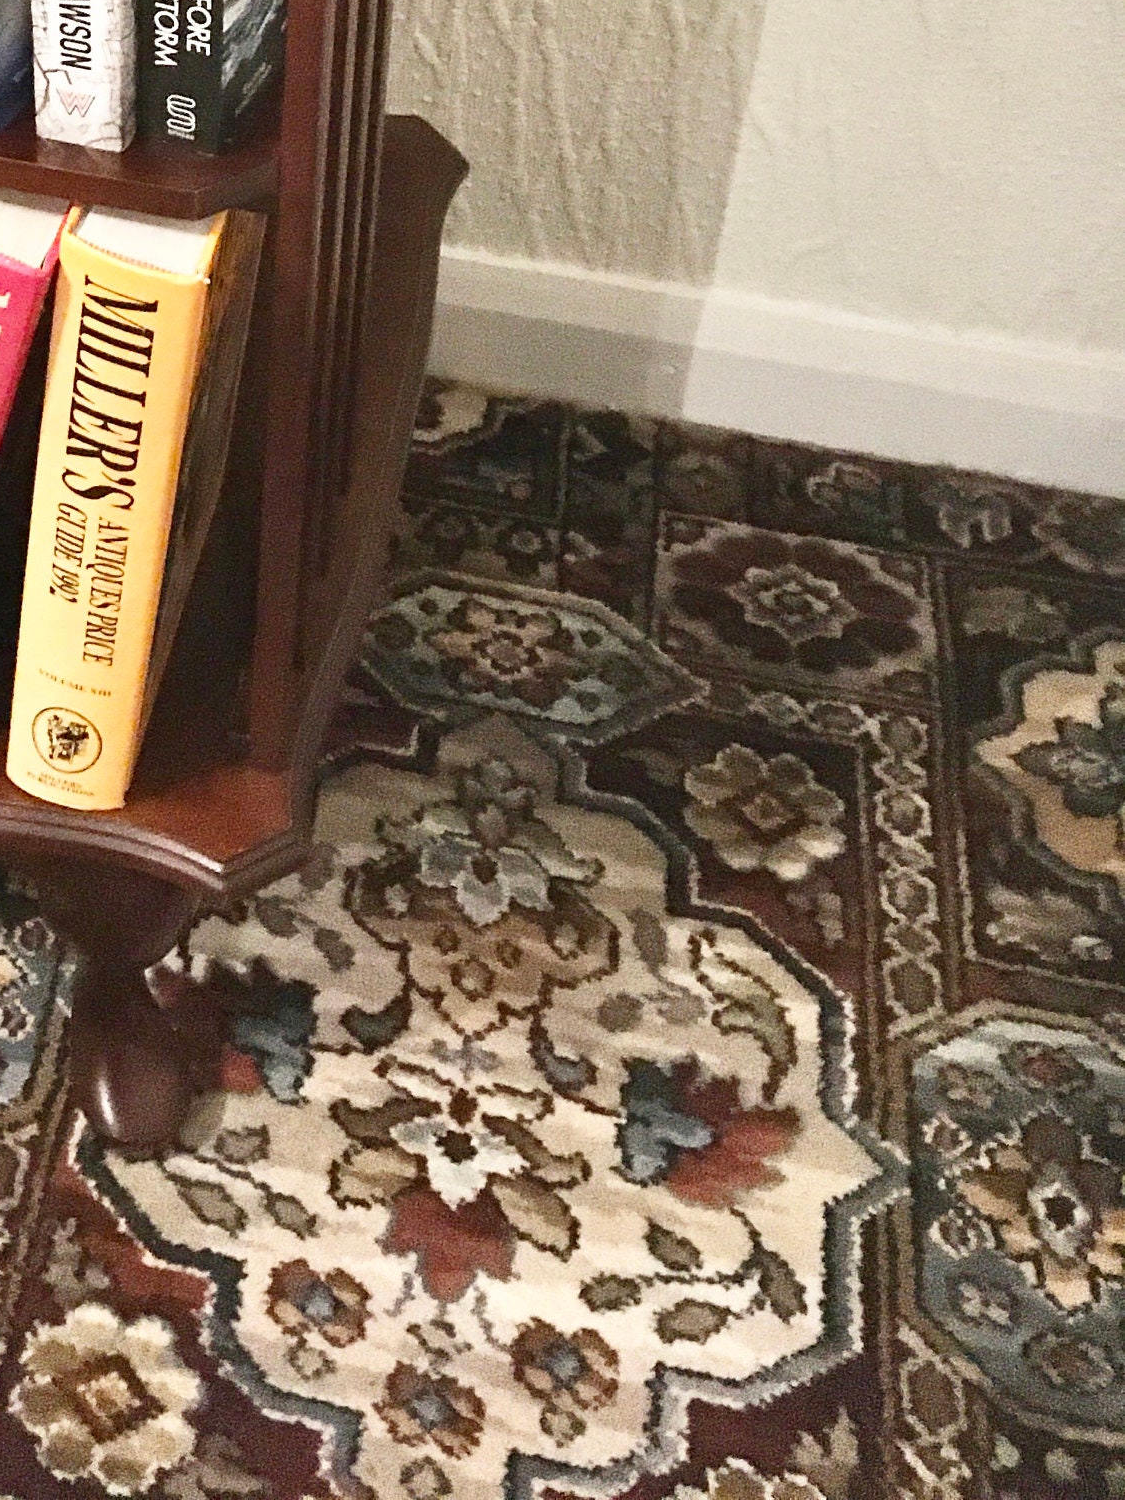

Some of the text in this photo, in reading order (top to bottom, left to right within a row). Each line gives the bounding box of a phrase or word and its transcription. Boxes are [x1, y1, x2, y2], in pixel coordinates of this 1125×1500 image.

[61, 274, 159, 511] MILLER'S
[55, 502, 87, 567] GUIDE
[82, 515, 130, 667] ANTIQUES PRICE
